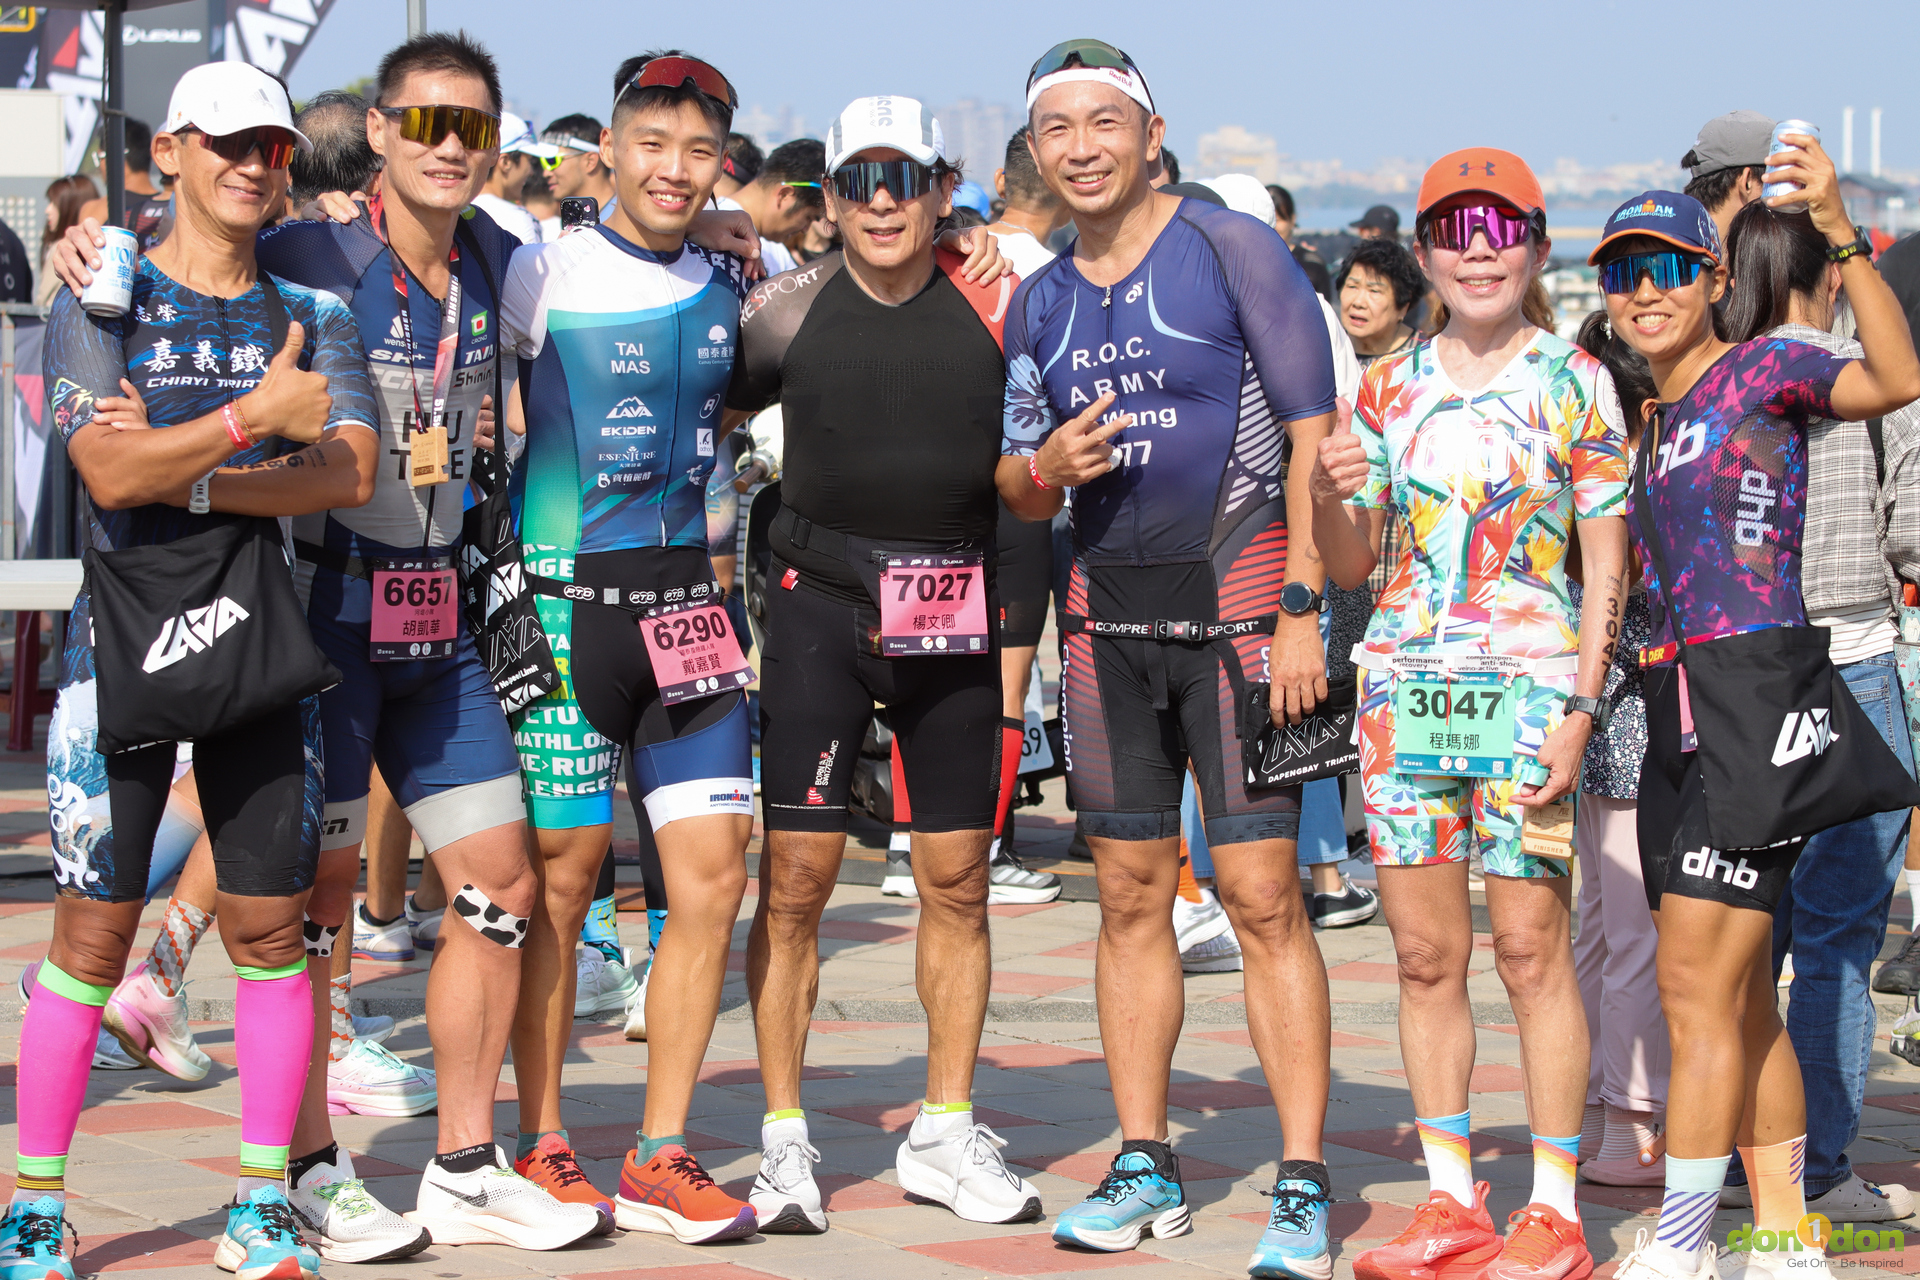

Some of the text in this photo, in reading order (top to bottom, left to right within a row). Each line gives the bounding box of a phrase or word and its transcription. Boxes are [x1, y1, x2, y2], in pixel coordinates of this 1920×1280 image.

[140, 28, 201, 43] LEXUS
[446, 275, 459, 325] FINISHER
[615, 342, 644, 356] TAI
[1072, 337, 1151, 371] R.O.C.
[610, 360, 651, 374] MAS
[146, 376, 209, 388] CHIAYI
[606, 406, 654, 419] LAVA
[1735, 469, 1777, 547] dhb
[383, 575, 453, 607] 6657
[892, 573, 973, 602] 7027
[653, 611, 727, 651] 6290
[912, 614, 956, 631] 楊文卿
[142, 596, 250, 674] LAVA
[1602, 597, 1619, 680] 3047
[681, 653, 723, 676] 戴嘉賢
[1392, 656, 1443, 664] performance
[1480, 660, 1522, 668] anti-shock
[1061, 644, 1073, 772] Champion
[1407, 688, 1503, 720] 3047
[1261, 715, 1340, 775] LAVA
[1429, 732, 1481, 751] 程瑪娜
[1268, 763, 1320, 784] DAPENGBAY
[709, 788, 750, 803] IRONMAN
[1533, 844, 1564, 854] FINISHER
[1681, 845, 1759, 890] dhb
[442, 1145, 486, 1161] PUYUMA
